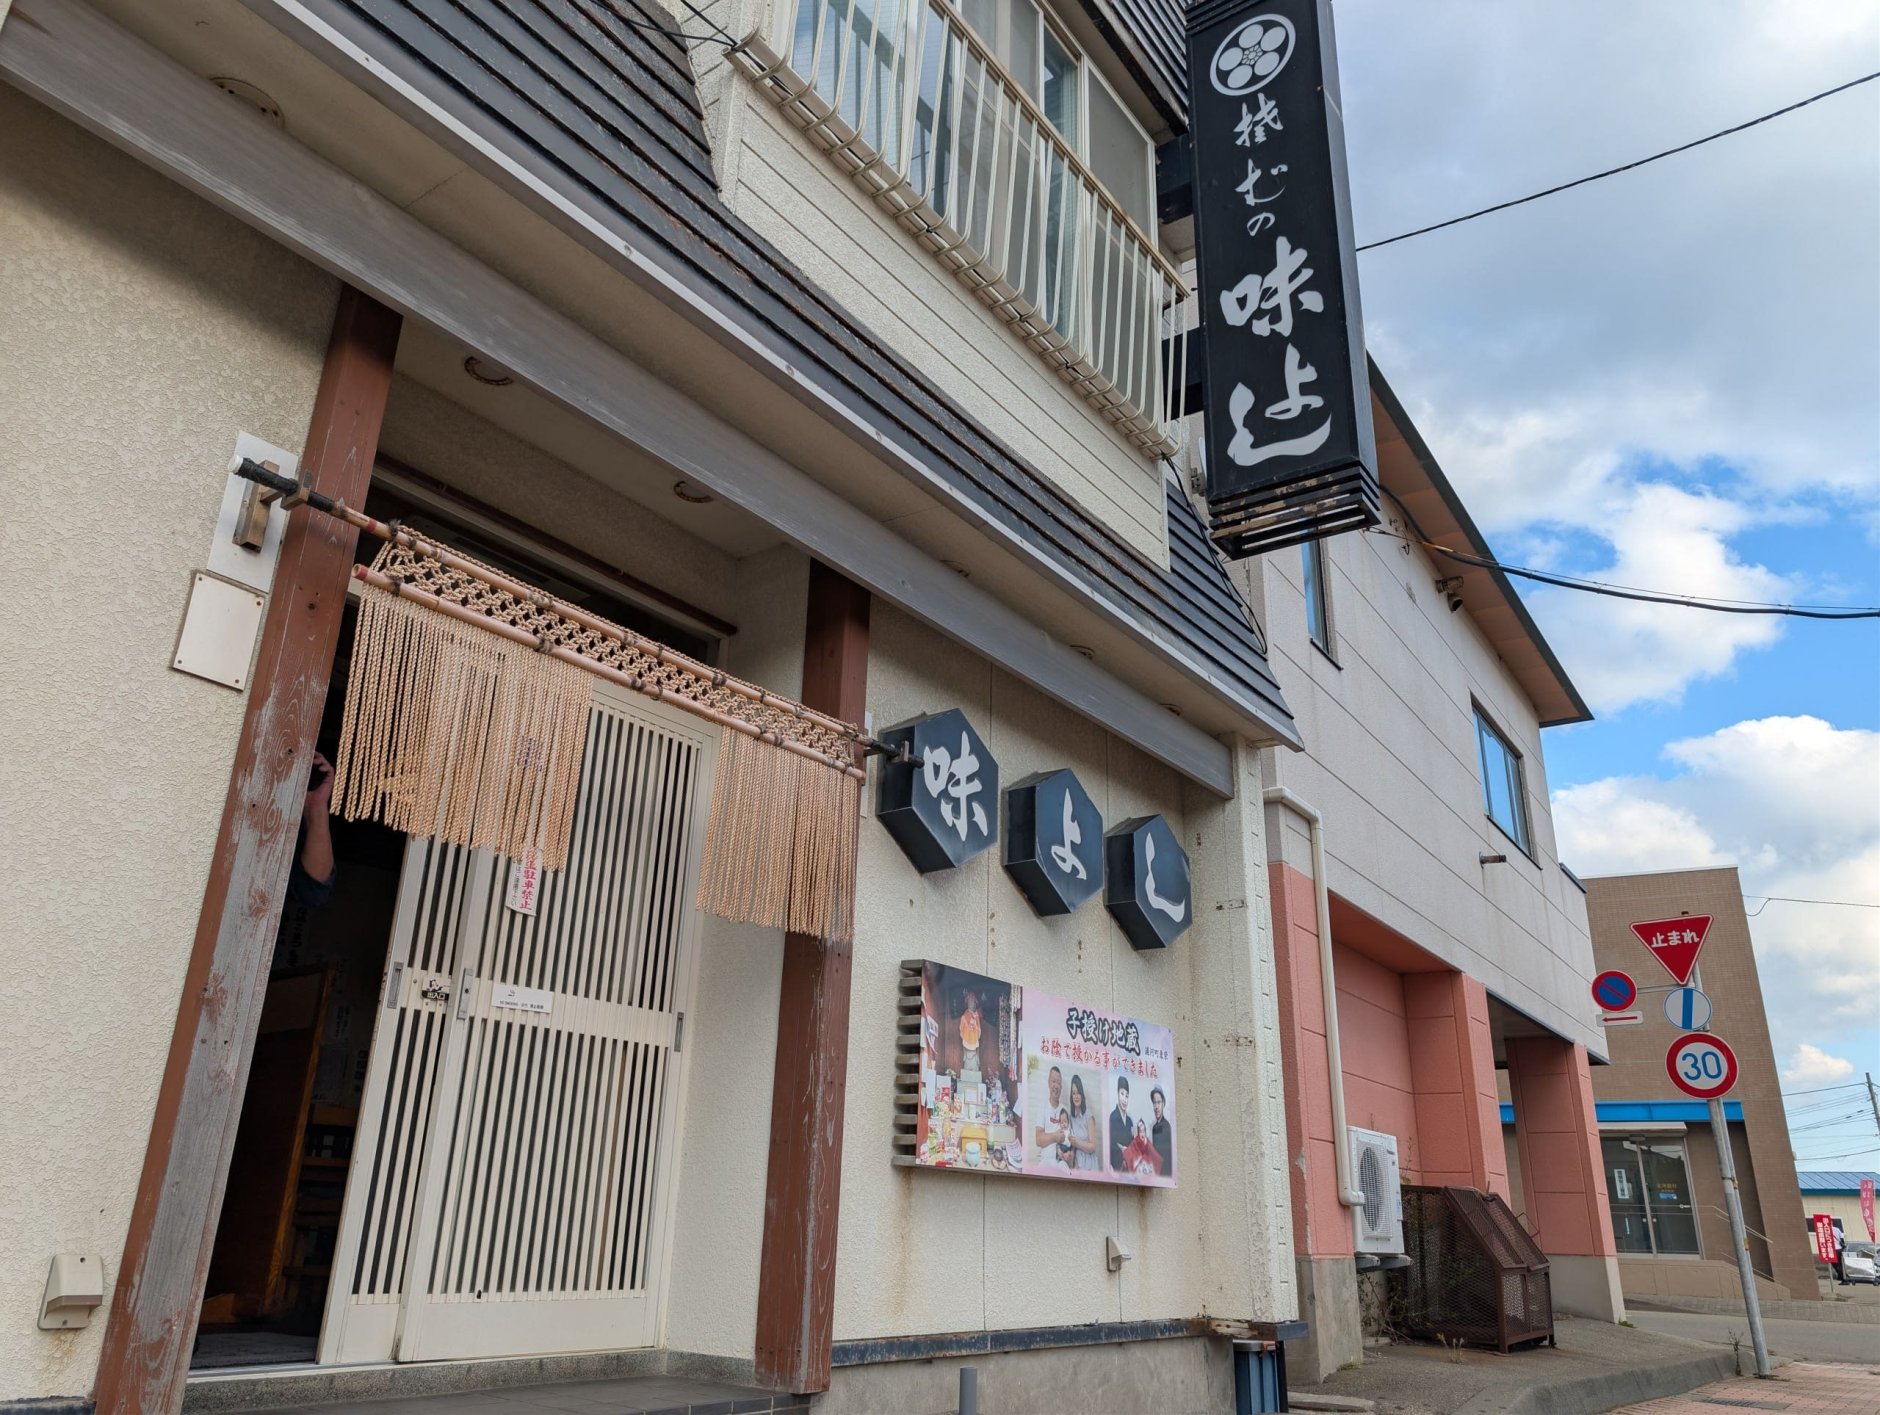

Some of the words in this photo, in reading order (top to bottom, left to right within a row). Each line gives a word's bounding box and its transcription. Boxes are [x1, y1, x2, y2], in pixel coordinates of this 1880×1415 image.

[1651, 929, 1701, 948] 止まれ
[426, 992, 446, 1001] 出入口
[1066, 1007, 1141, 1057] 子授け地蔵
[1681, 1050, 1723, 1081] 30
